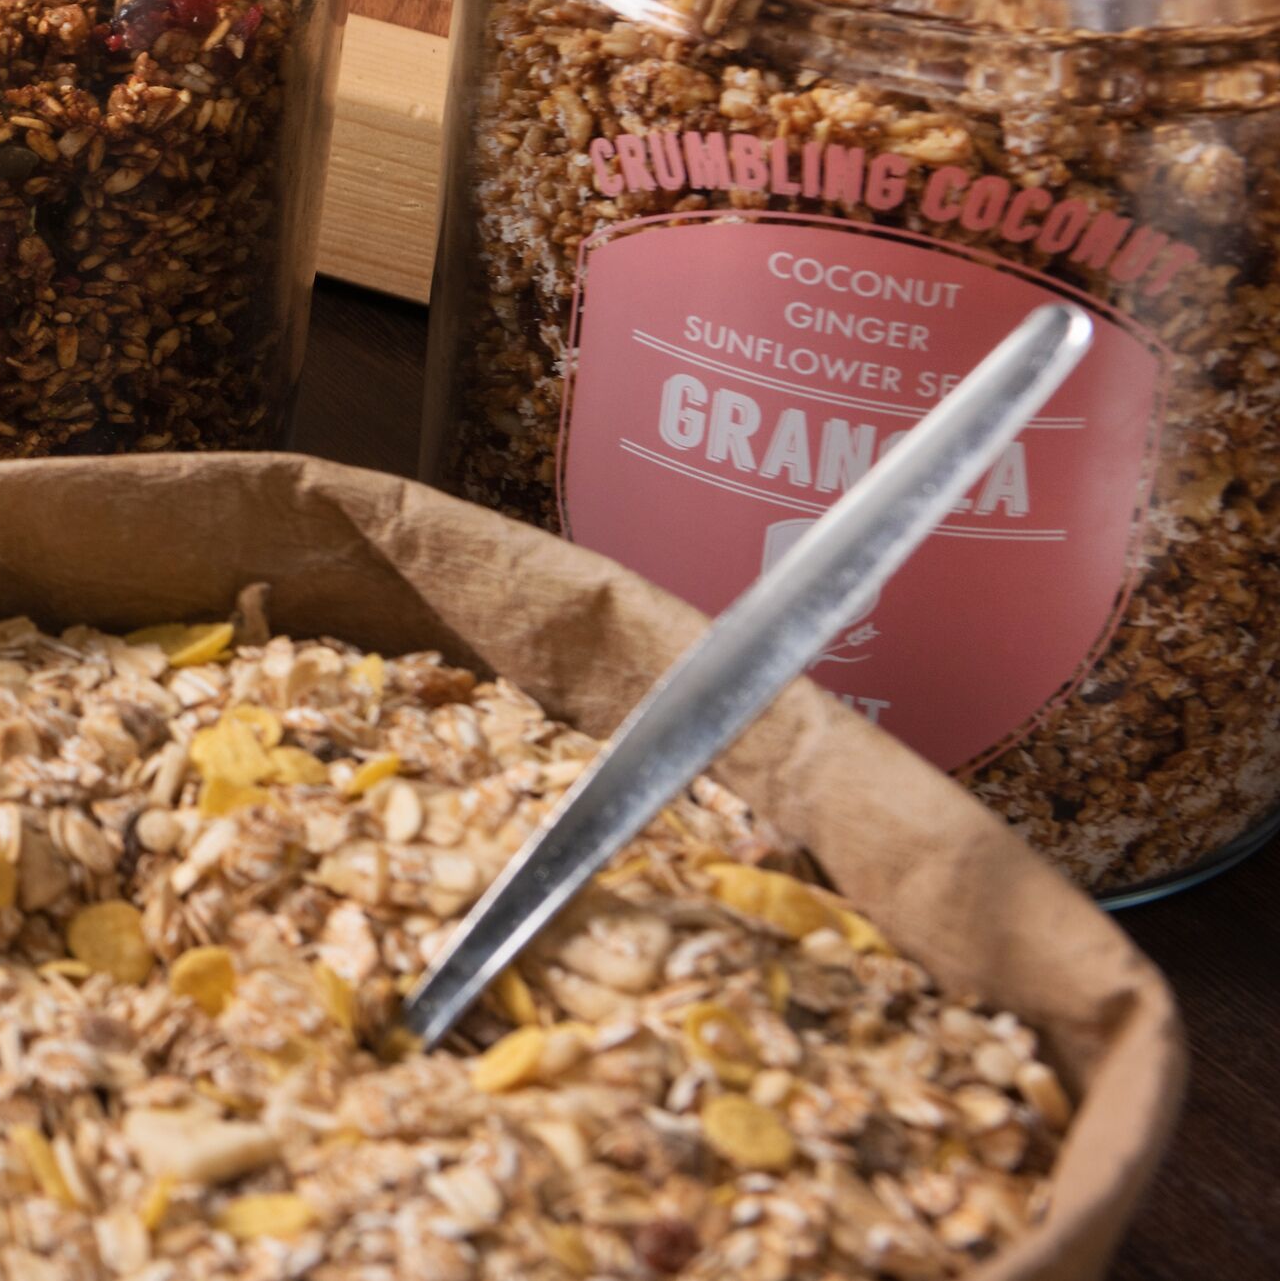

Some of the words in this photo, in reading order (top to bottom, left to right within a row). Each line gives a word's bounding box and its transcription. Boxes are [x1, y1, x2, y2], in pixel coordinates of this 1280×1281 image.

[589, 130, 911, 213] CRUMBLING
[919, 165, 1200, 297] COCONUT
[767, 249, 965, 311] COCONUT
[683, 314, 901, 396] SUNFLOWER
[783, 300, 930, 354] GINGER
[659, 372, 1031, 518] GRANA
